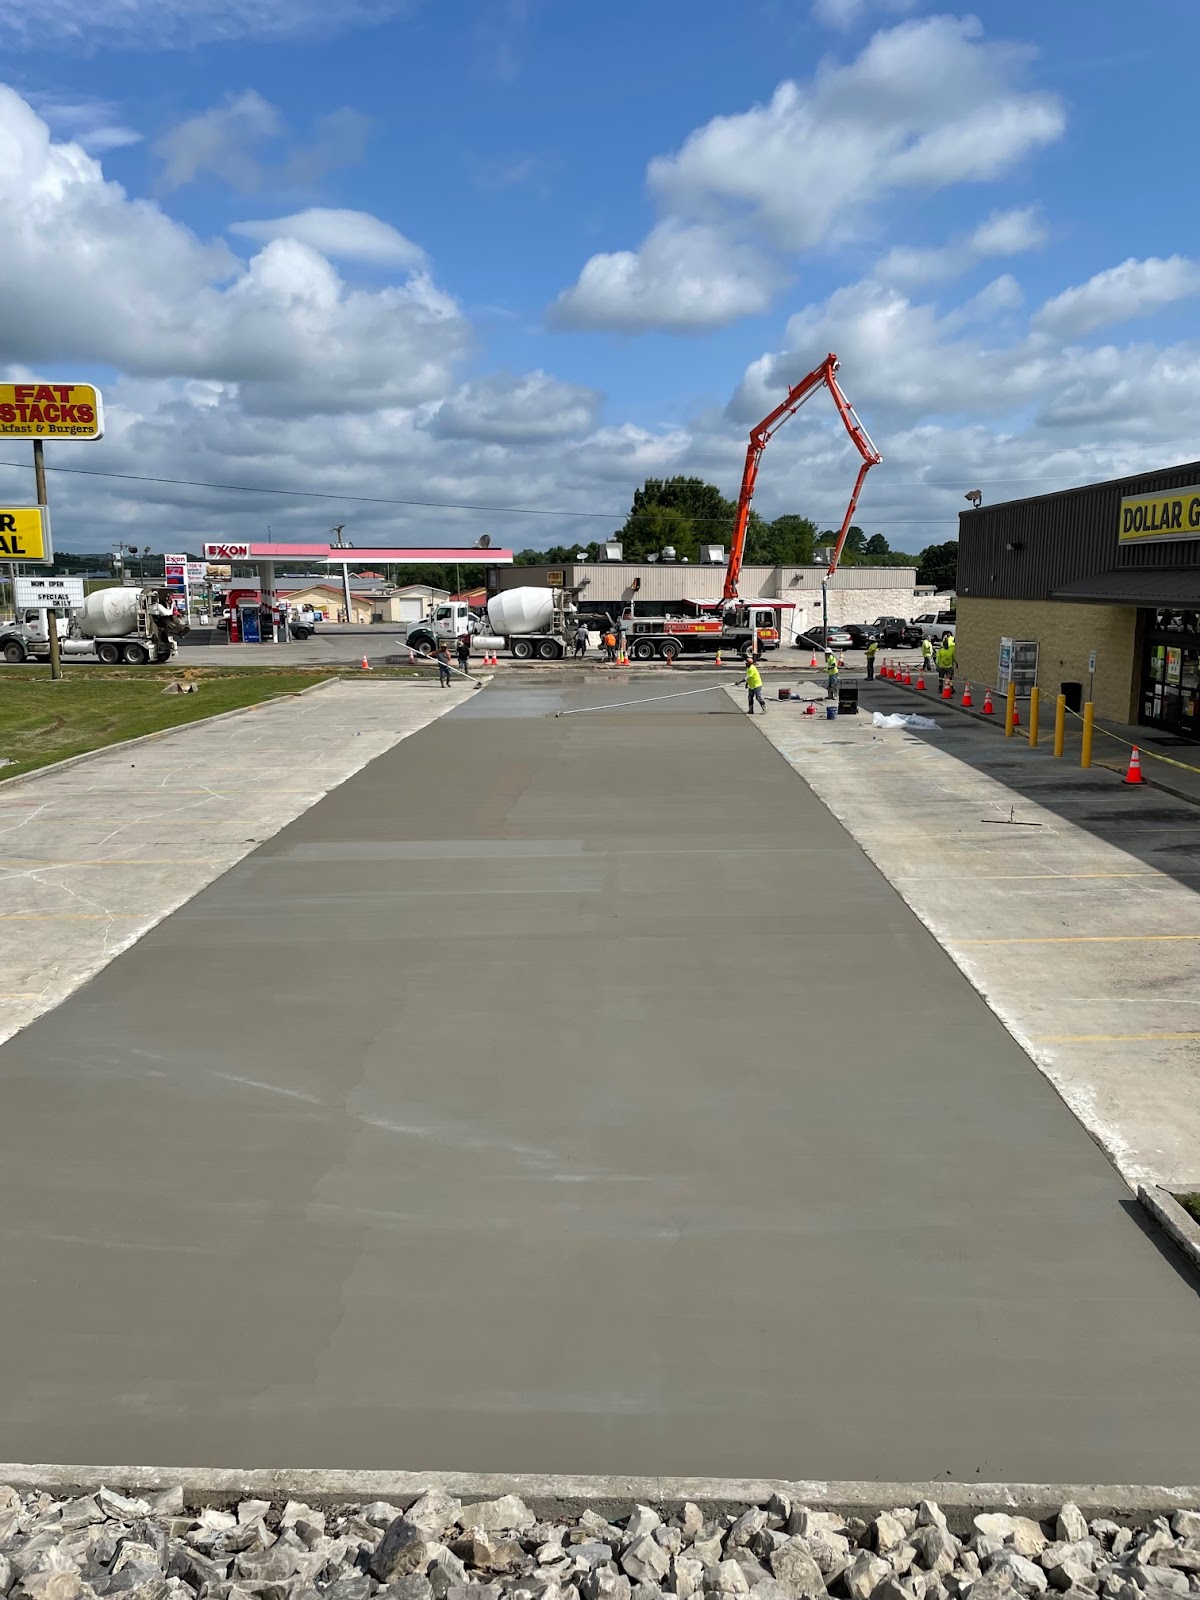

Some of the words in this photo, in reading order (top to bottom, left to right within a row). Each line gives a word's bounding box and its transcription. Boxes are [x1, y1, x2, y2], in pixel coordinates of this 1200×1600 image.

[14, 385, 75, 403] FAT
[0, 403, 95, 423] STACKS
[0, 424, 32, 433] kfast
[36, 424, 44, 433] &
[48, 424, 94, 436] Burgers
[1123, 501, 1183, 533] DOLLAR
[166, 556, 185, 564] Exxon
[208, 545, 247, 559] EXXON
